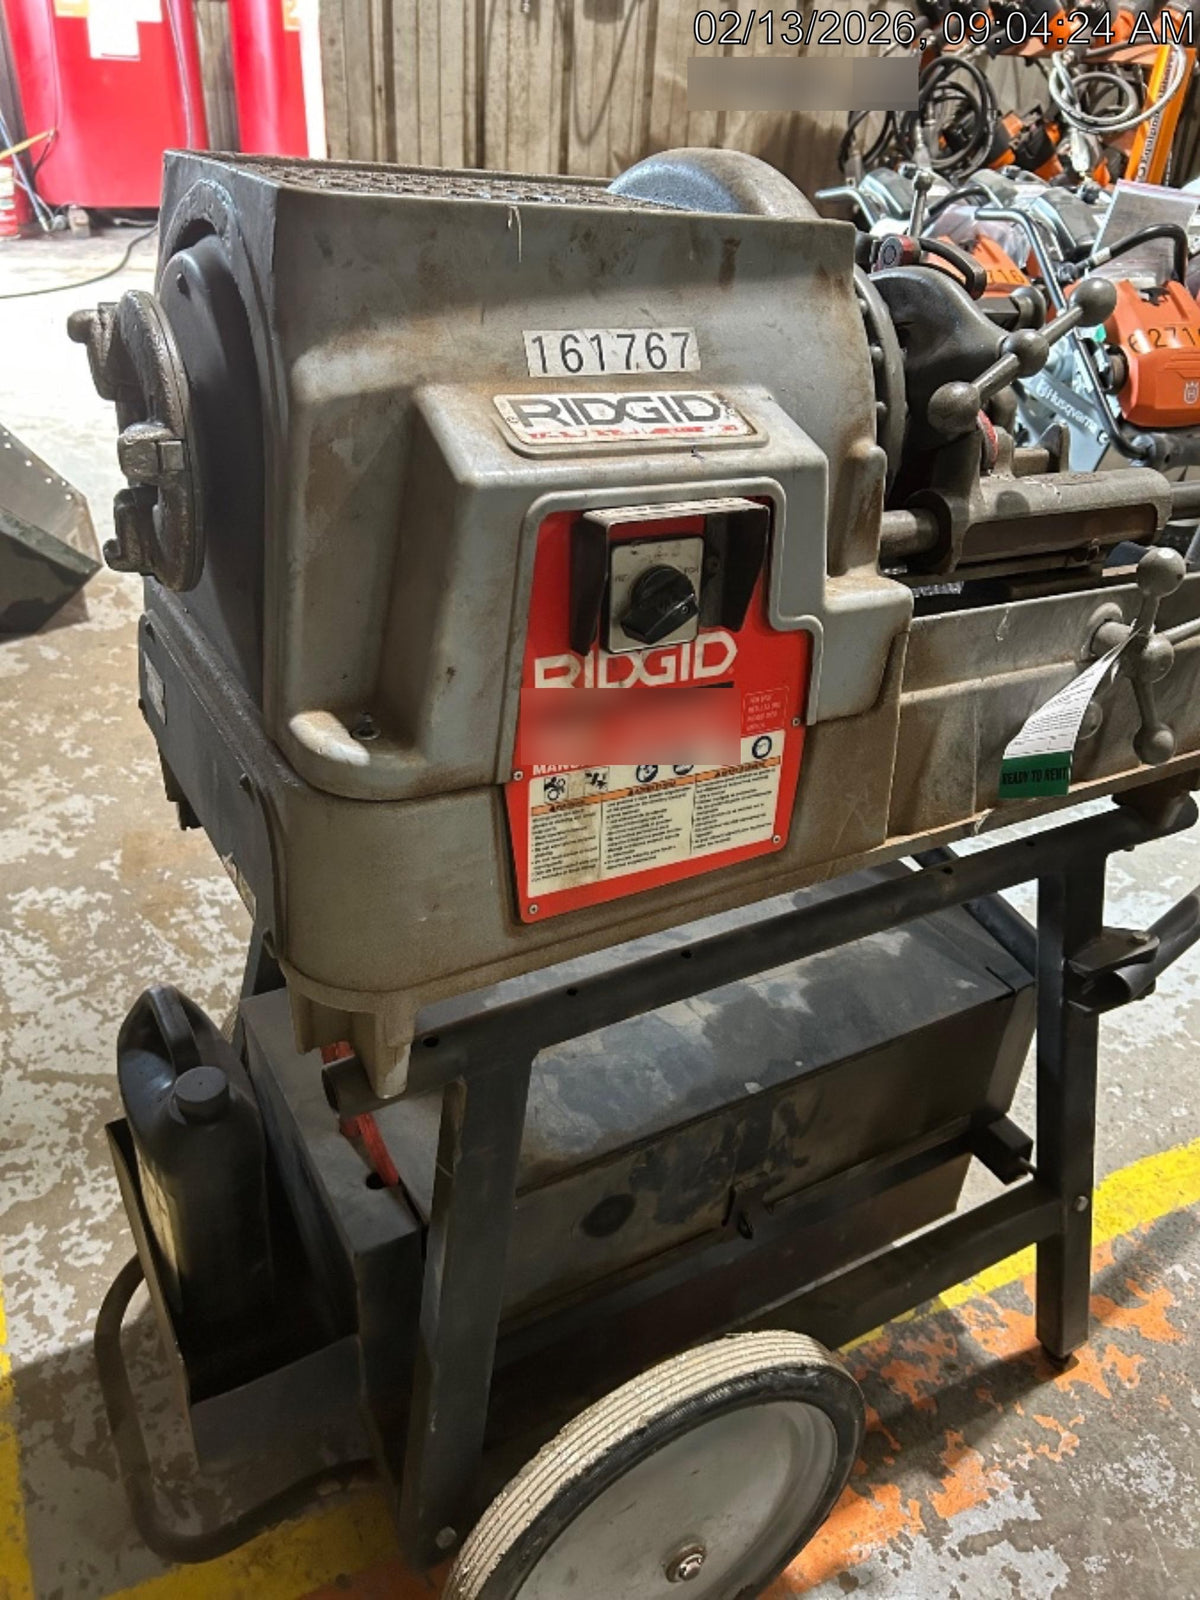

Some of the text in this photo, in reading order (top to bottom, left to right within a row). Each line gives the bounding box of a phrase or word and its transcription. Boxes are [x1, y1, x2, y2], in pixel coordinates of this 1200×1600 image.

[531, 331, 690, 374] 161767
[1127, 326, 1200, 354] 6271
[507, 393, 722, 429] RIDGID
[533, 630, 739, 689] RIDGID
[1002, 766, 1068, 786] READY TO RENT
